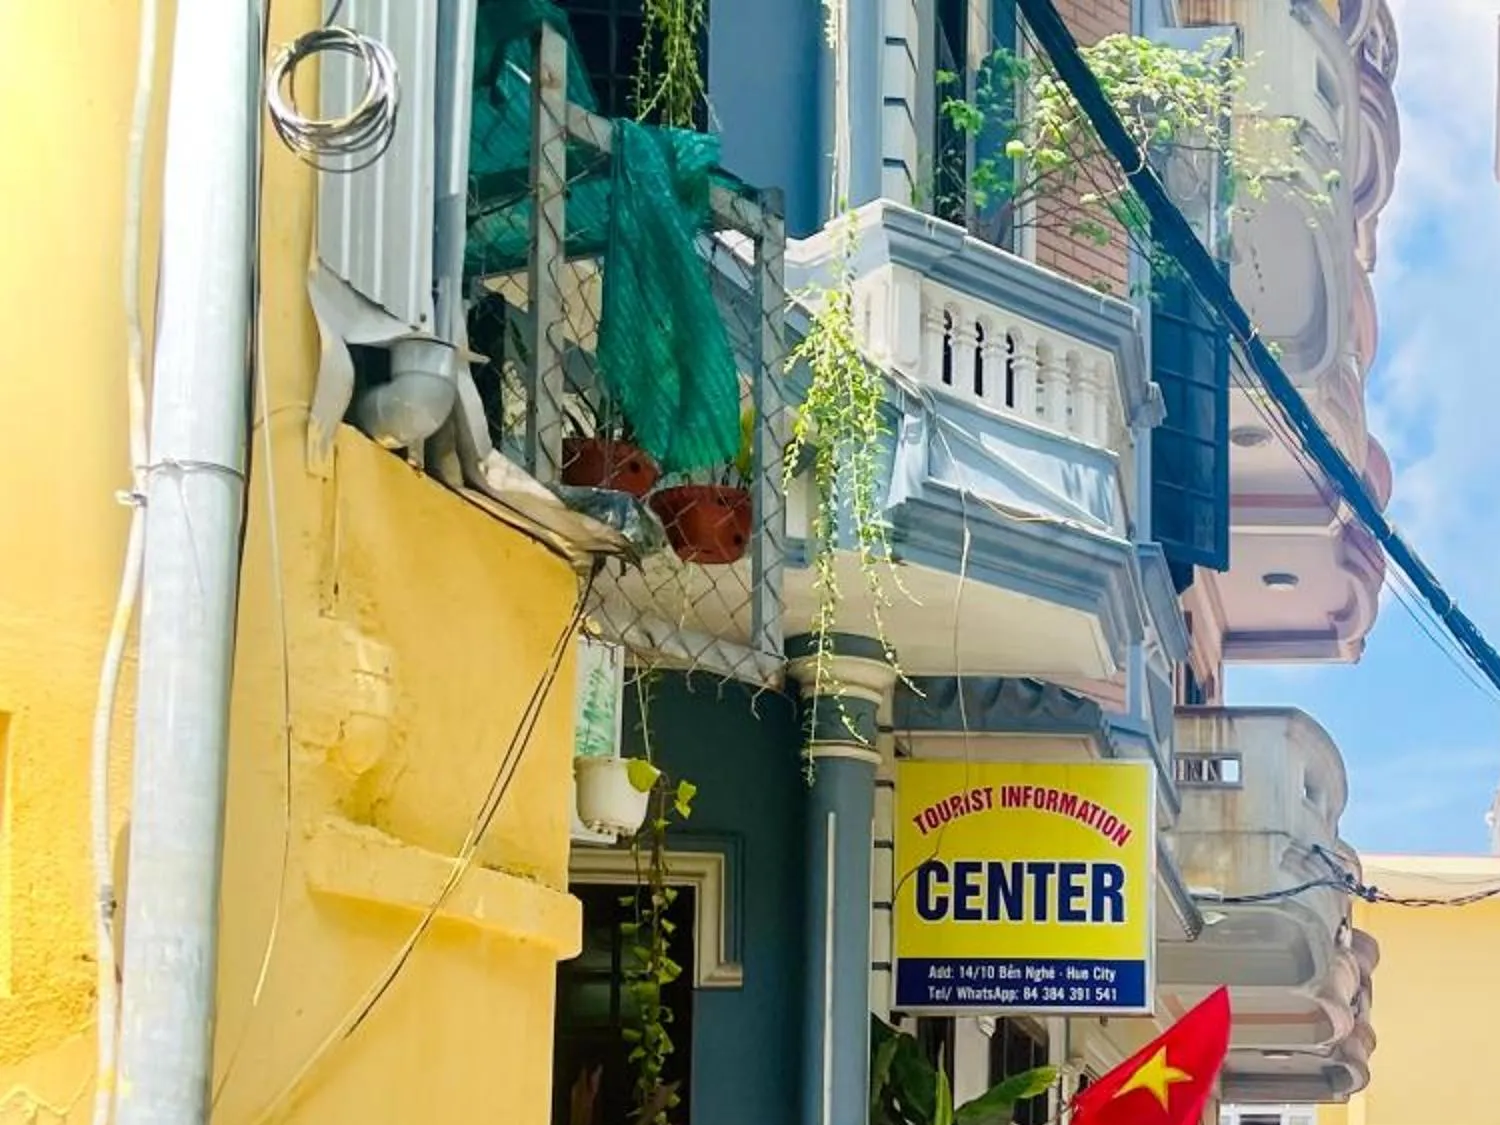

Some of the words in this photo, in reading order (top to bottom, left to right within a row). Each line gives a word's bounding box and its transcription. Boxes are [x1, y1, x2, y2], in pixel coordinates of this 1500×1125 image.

[913, 787, 993, 836] TOURIST
[1001, 785, 1132, 848] INFORMATION
[916, 860, 1125, 922] CENTER
[959, 965, 994, 980] 14/10
[1093, 966, 1116, 983] City
[956, 986, 1019, 1003] WhatsApp:
[1023, 987, 1038, 1001] 84
[1042, 987, 1064, 1001] 384
[1069, 987, 1090, 1001] 391
[1095, 987, 1117, 1001] 541
